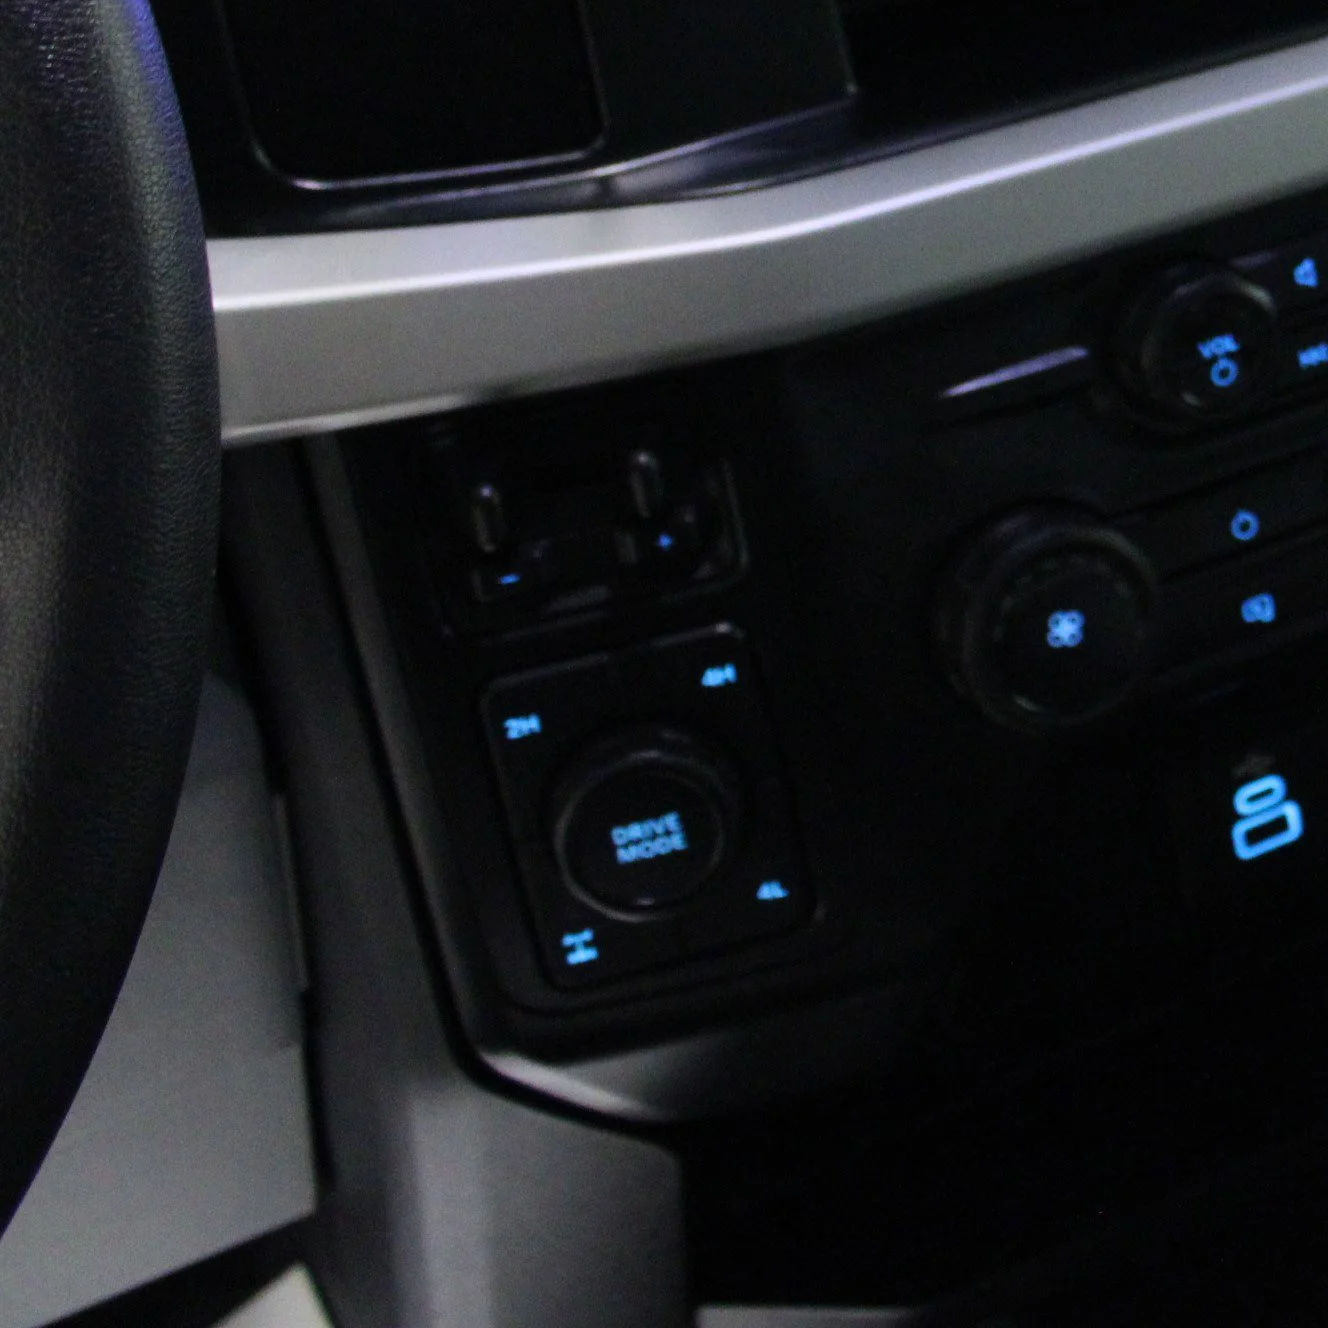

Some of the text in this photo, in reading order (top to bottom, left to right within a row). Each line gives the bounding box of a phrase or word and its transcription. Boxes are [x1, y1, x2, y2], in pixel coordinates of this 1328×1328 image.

[702, 663, 736, 687] 4H
[504, 713, 541, 739] 2H
[611, 811, 681, 845] DRIVE
[616, 832, 687, 864] MODE
